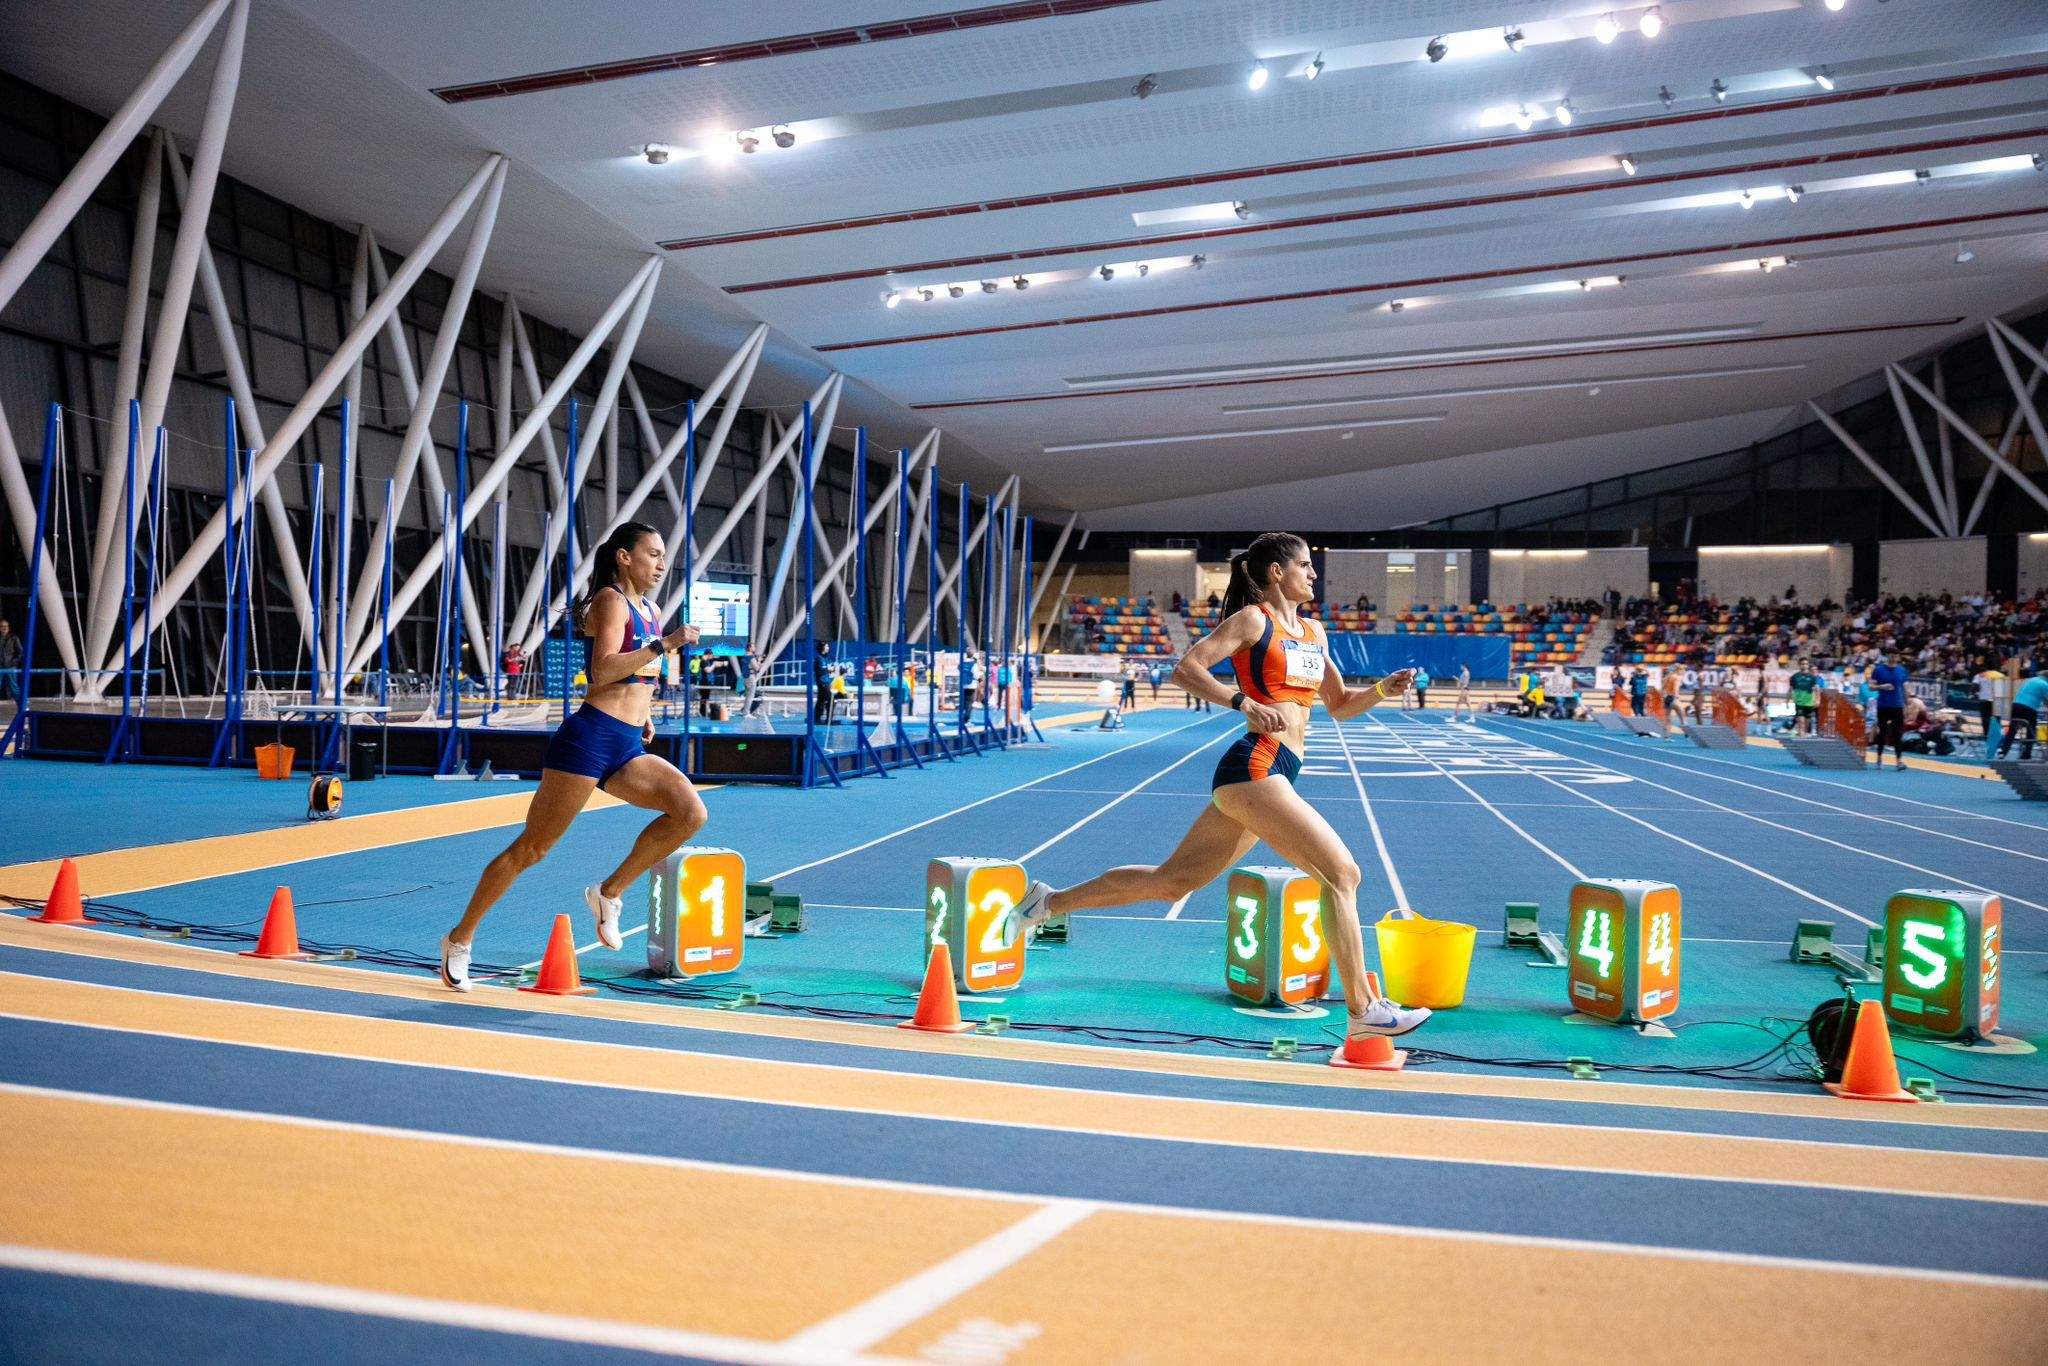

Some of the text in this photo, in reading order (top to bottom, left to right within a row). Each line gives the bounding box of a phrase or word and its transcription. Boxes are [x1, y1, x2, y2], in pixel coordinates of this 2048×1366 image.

[1301, 656, 1320, 670] 135
[699, 875, 725, 938] 1
[930, 886, 948, 945] 2
[979, 888, 1014, 953] 2
[1233, 895, 1259, 960] 3
[1291, 899, 1322, 963] 3
[1578, 909, 1614, 978] 4
[1646, 911, 1674, 977] 4
[1899, 920, 1948, 990] 5
